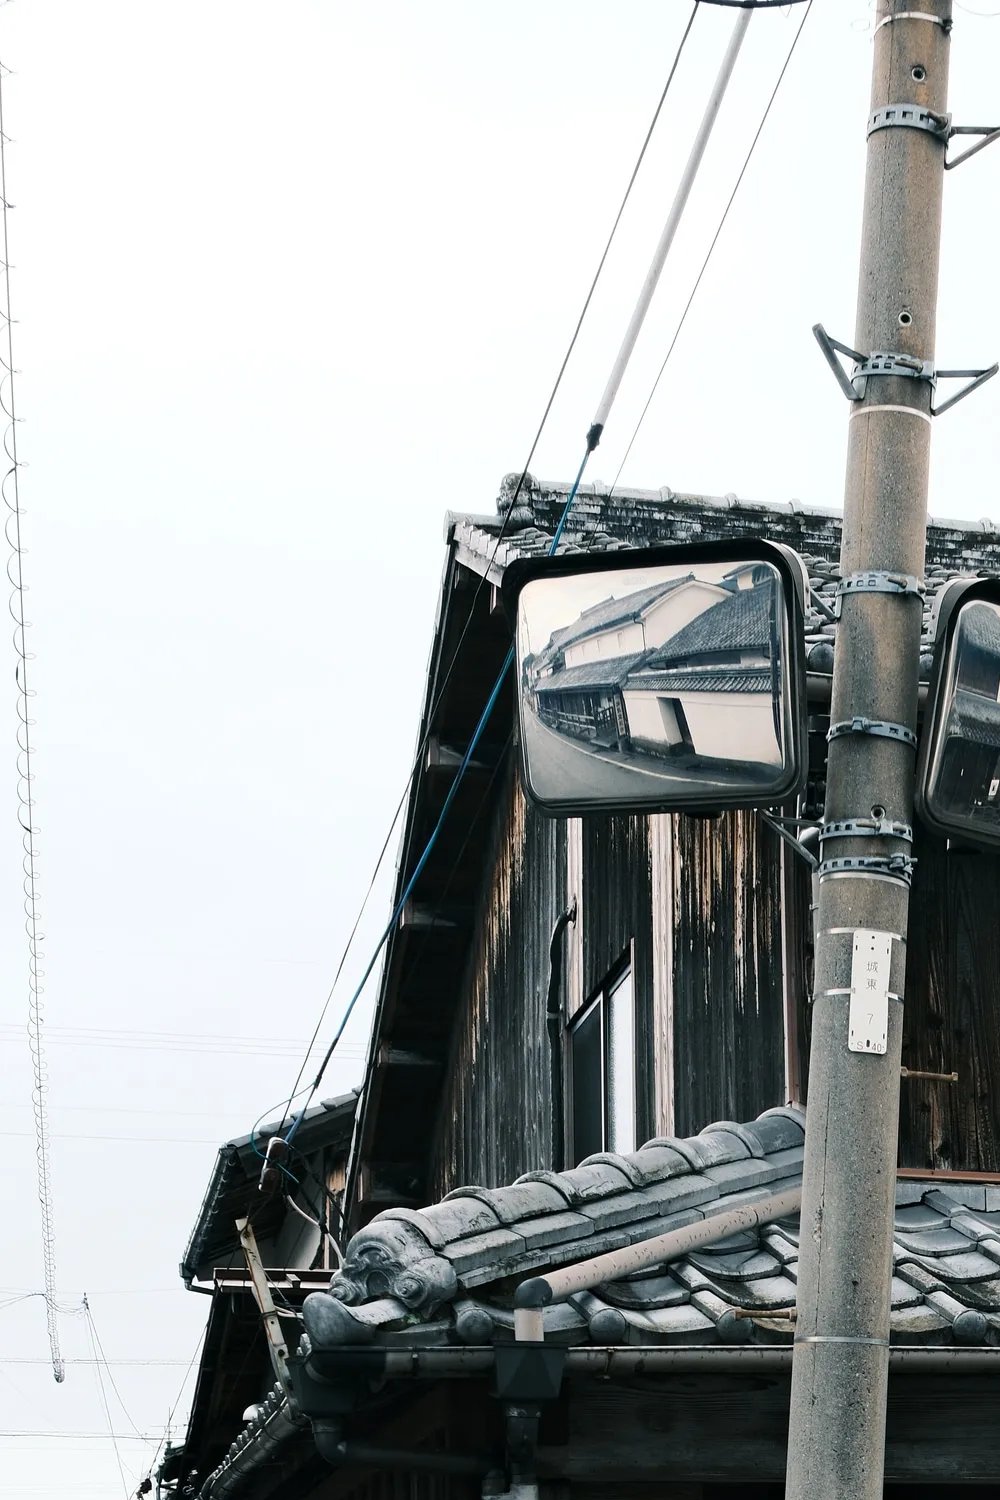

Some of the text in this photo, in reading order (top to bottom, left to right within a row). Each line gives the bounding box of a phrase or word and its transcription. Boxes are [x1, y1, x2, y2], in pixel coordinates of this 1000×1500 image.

[866, 961, 879, 1025] 城東 7
[856, 1041, 882, 1053] S 40
